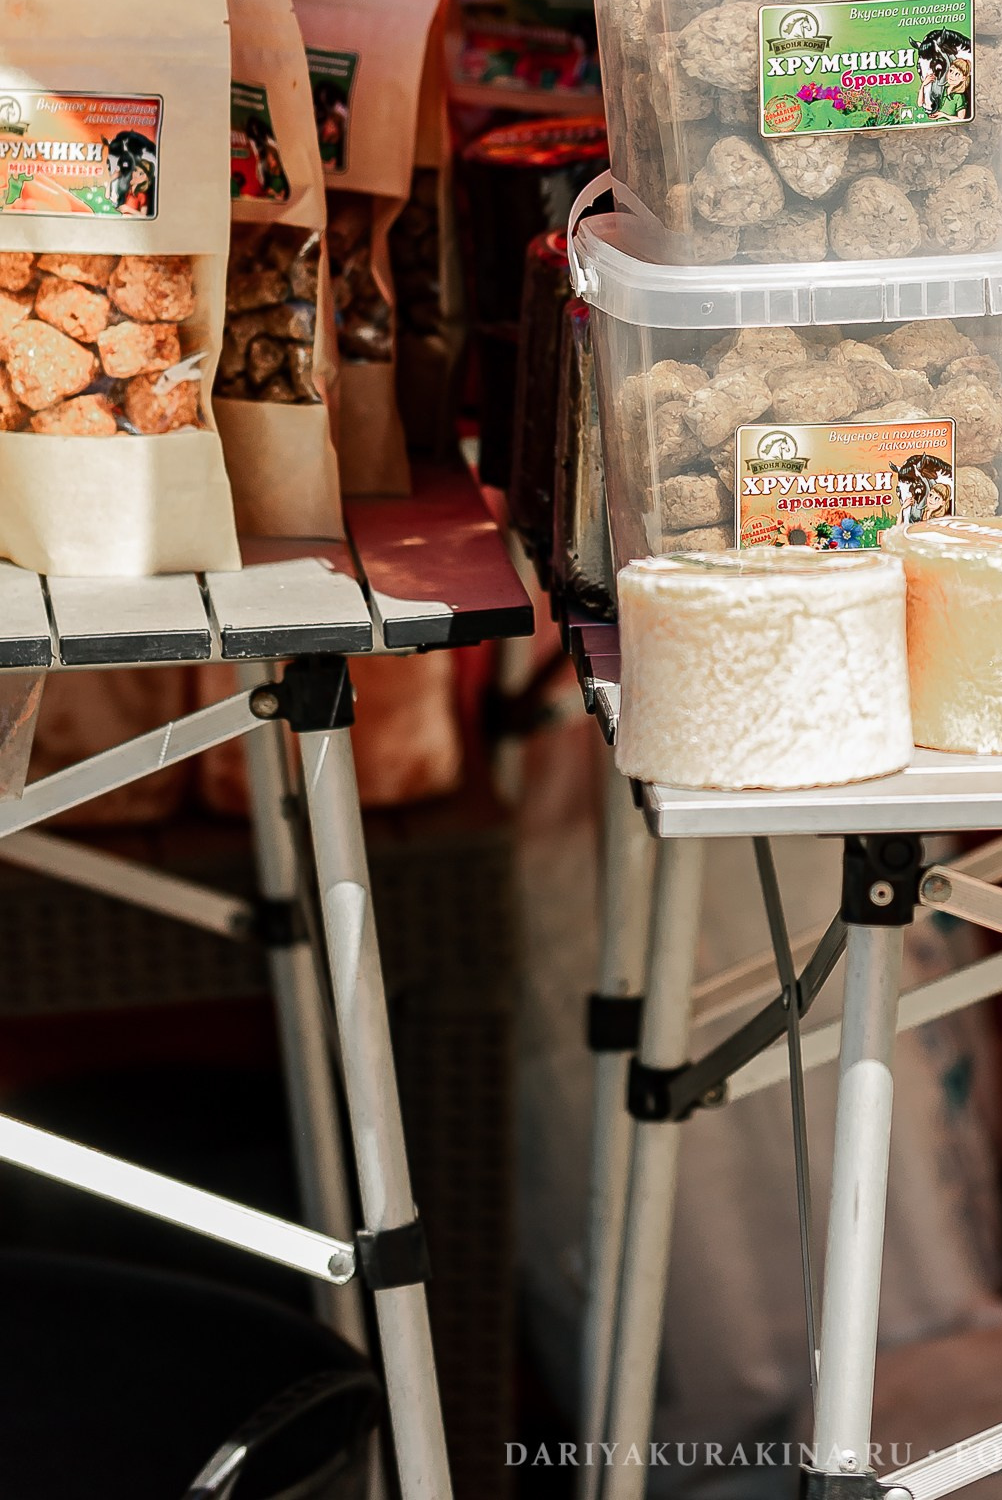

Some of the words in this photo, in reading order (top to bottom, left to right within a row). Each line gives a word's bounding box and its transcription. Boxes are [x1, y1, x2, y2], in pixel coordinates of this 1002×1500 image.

[849, 7, 899, 21] Вкусное
[902, 8, 909, 16] и
[911, 1, 966, 16] полезное
[897, 12, 966, 27] лакомство
[781, 41, 802, 51] КОНЯ
[803, 41, 823, 50] КОРМ
[767, 48, 915, 77] ХРУМЧИКИ
[841, 69, 914, 91] бронхо
[36, 98, 87, 113] Вкусное
[99, 103, 158, 116] полезное
[83, 113, 157, 127] лакомство
[829, 430, 879, 445] Вкусное
[881, 432, 889, 440] и
[891, 427, 948, 440] полезное
[877, 439, 948, 451] лакомство
[742, 472, 894, 496] ХРУМЧИКИ
[777, 493, 893, 512] ароматные
